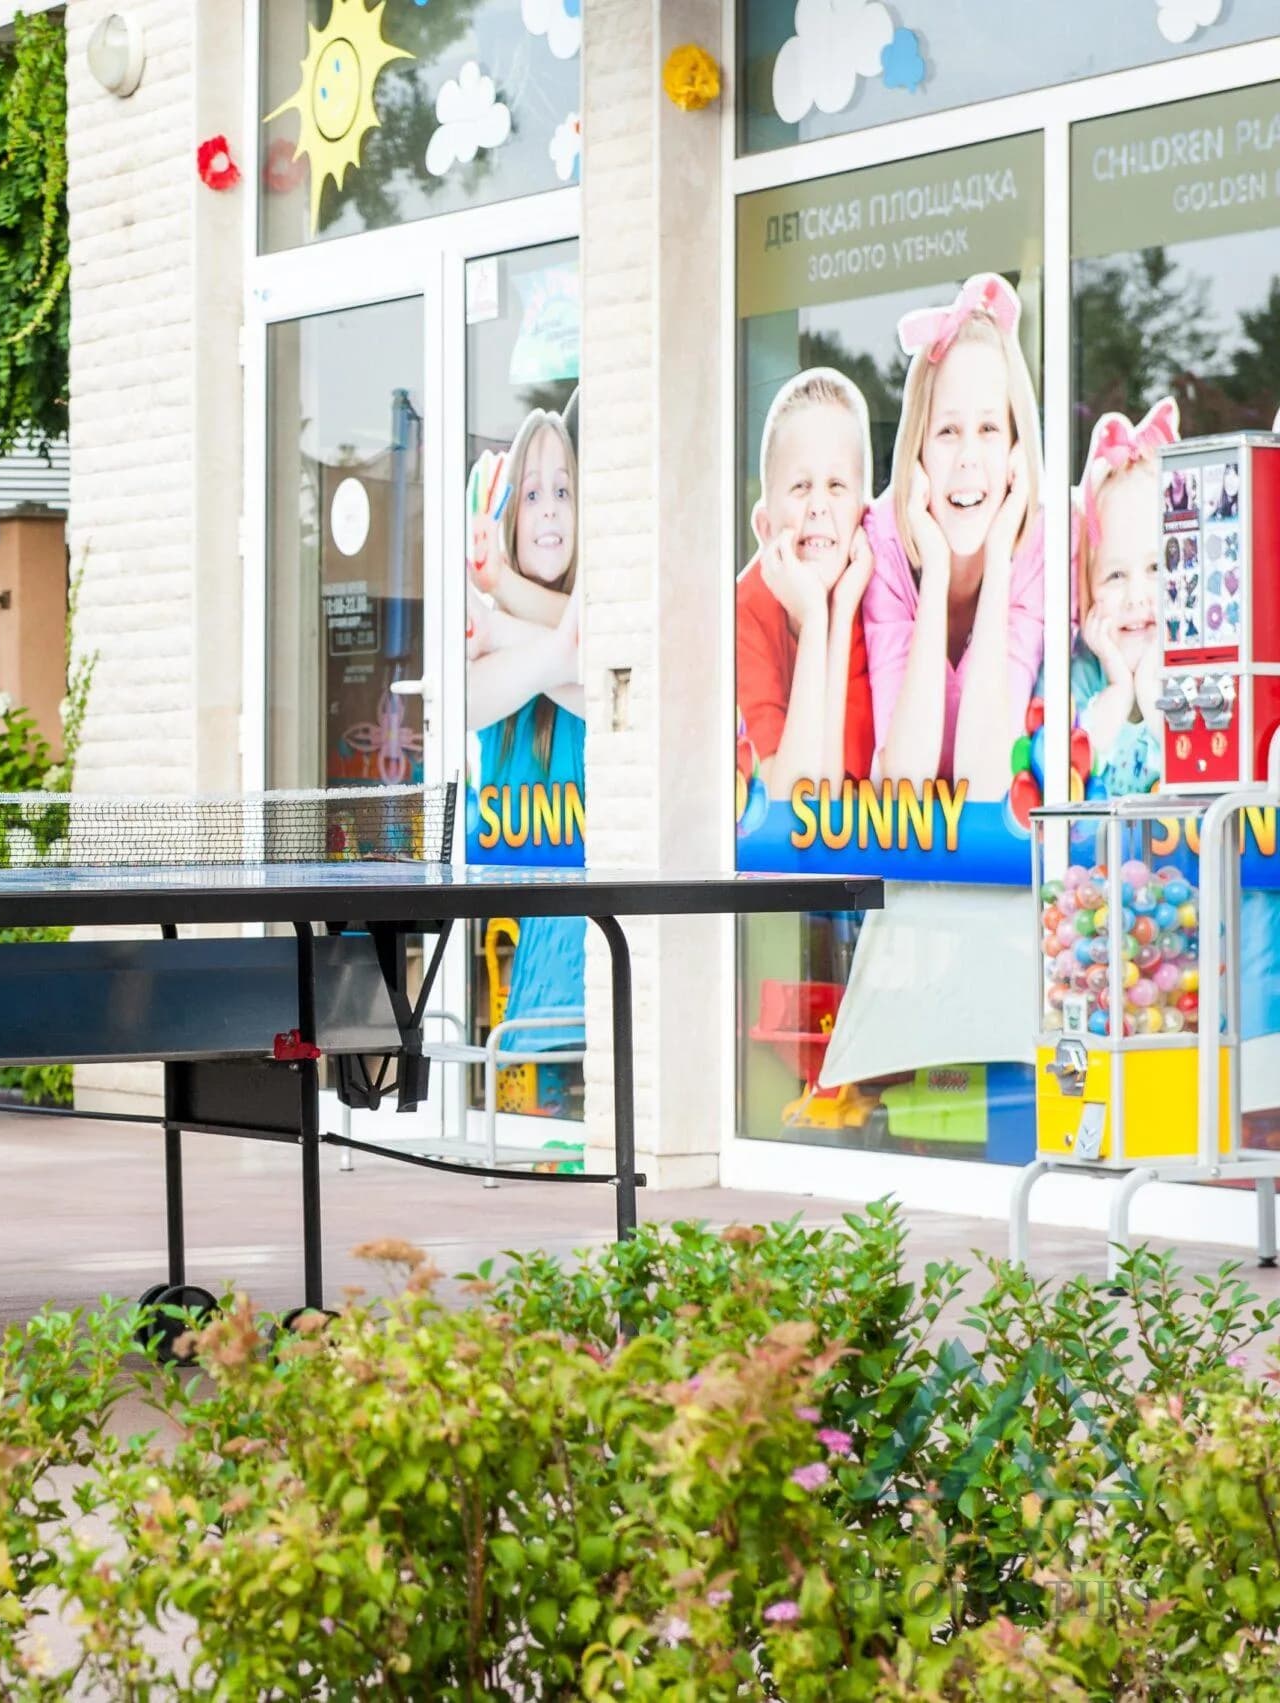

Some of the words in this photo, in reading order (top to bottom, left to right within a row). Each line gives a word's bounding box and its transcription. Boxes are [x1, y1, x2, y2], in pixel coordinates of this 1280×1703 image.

[1091, 125, 1224, 182] CHILDREN
[764, 200, 862, 251] ДЕТСКАЯ
[869, 168, 1017, 227] ПЛОЩАДКА
[1173, 168, 1267, 213] GOLDEN
[808, 243, 886, 282] ЗОЛОТО
[892, 227, 969, 269] УТЕНОК
[790, 777, 969, 851] SUNNY
